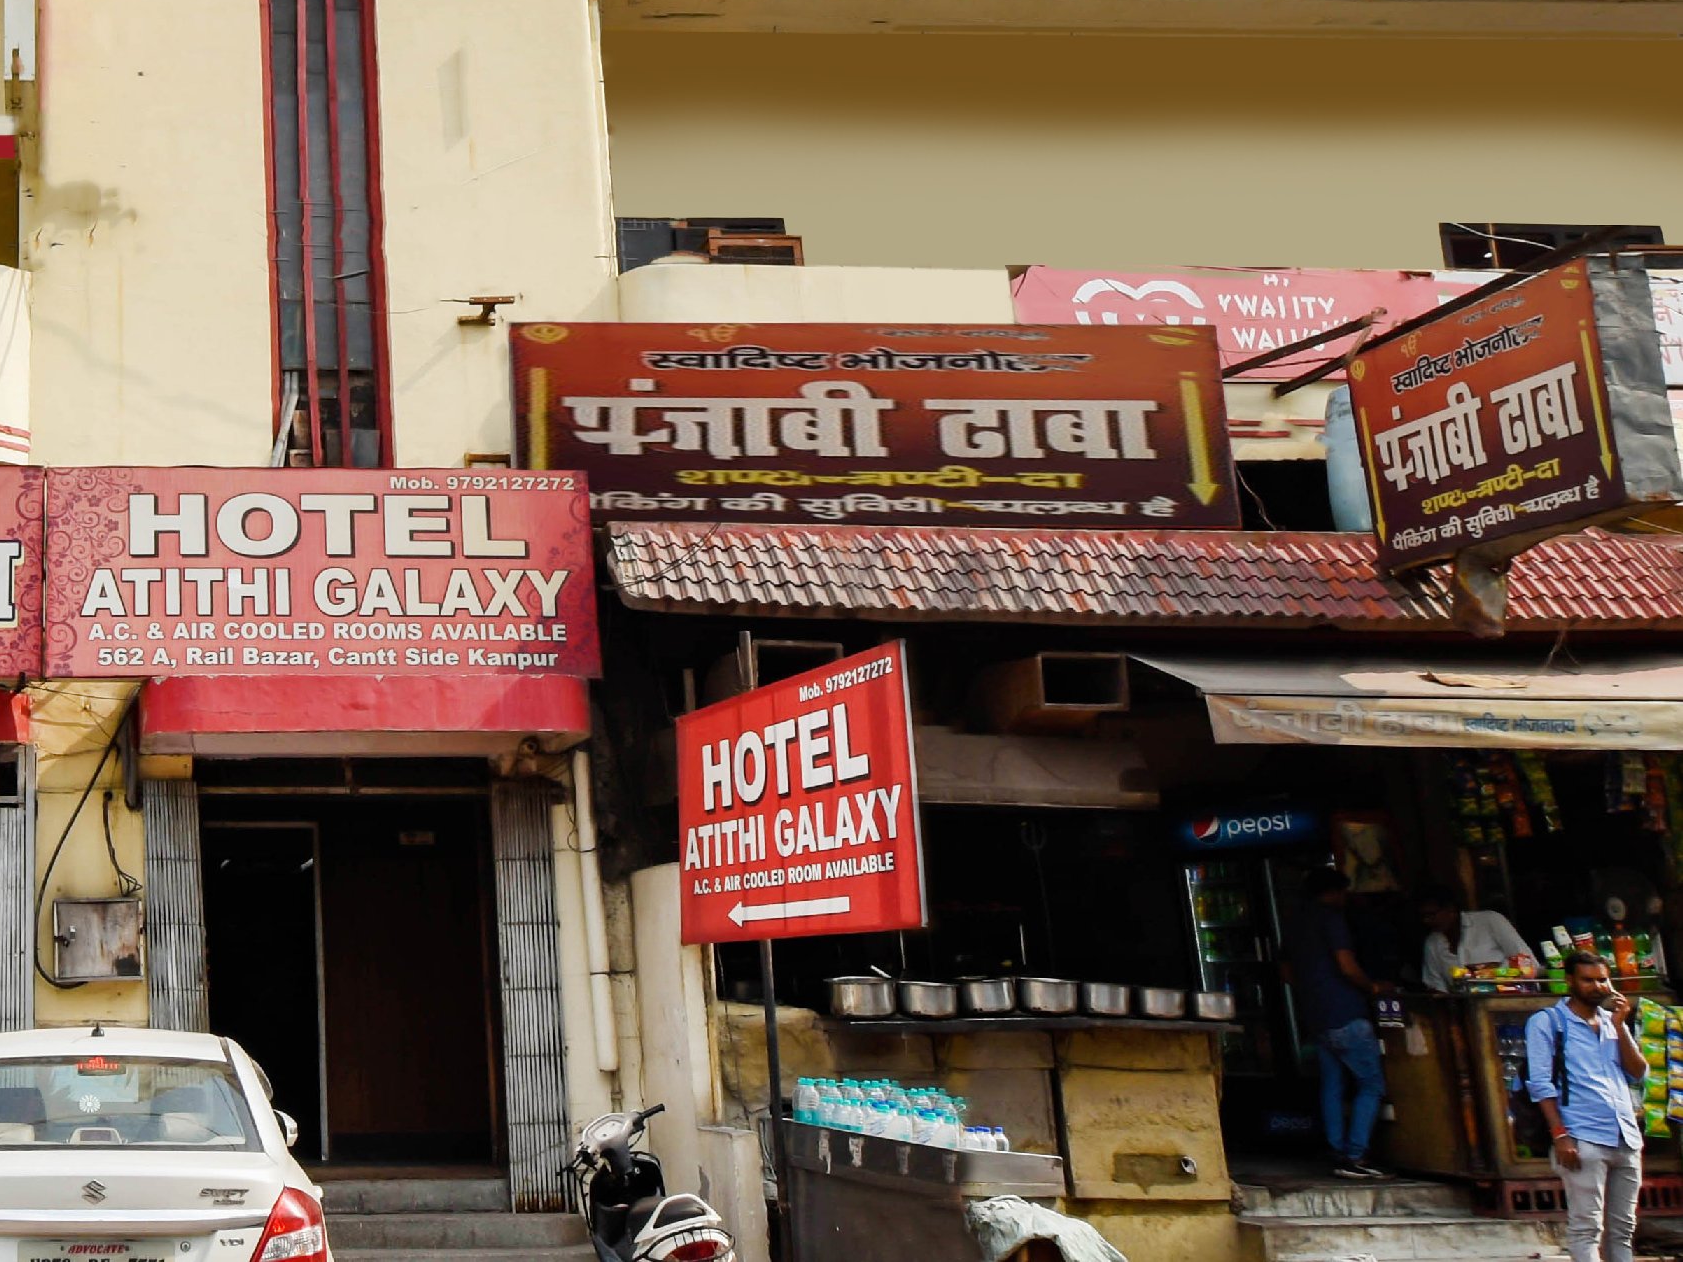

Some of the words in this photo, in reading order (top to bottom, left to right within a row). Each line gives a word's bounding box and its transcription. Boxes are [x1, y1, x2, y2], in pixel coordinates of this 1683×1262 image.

[642, 345, 829, 370] स्वादिष्ट
[1391, 353, 1452, 394] स्वादिष्ट
[562, 378, 895, 459] पंजाबी
[923, 399, 1158, 459] ढाबा
[1375, 381, 1487, 492] पंजाबी
[1490, 361, 1584, 455] ढाबा
[390, 476, 439, 491] Mob.
[446, 476, 575, 491] 9792127272
[719, 493, 787, 512] की
[1139, 496, 1178, 517] है
[128, 493, 527, 559] HOTEL
[1439, 518, 1462, 539] की
[1584, 474, 1601, 499] है
[80, 567, 292, 617] ATITHI
[313, 567, 569, 618] GALAXY
[89, 622, 139, 641] A.C.
[147, 622, 164, 641] &
[172, 622, 216, 641] AIR
[224, 622, 326, 641] COOLED
[333, 622, 423, 641] ROOMS
[430, 622, 567, 641] AVAILABLE
[97, 647, 143, 666] 562
[151, 647, 178, 670] A,
[185, 647, 234, 666] Rail
[243, 647, 321, 670] Bazar,
[329, 647, 398, 666] Cantt
[405, 647, 459, 666] Side
[468, 648, 559, 670] Kanpur
[799, 681, 823, 702] Mob.
[825, 656, 893, 694] 9792127272
[702, 703, 869, 812] HOTEL
[684, 814, 766, 871] ATITHI
[774, 784, 902, 858] GALAXY
[1227, 810, 1290, 839] pepsi
[694, 879, 712, 895] A.C.
[714, 876, 722, 893] &
[724, 874, 741, 892] AIR
[743, 868, 785, 889] COOLED
[787, 864, 822, 884] ROOM
[825, 852, 894, 880] AVAILABLE
[68, 1244, 125, 1254] ADVOCATE
